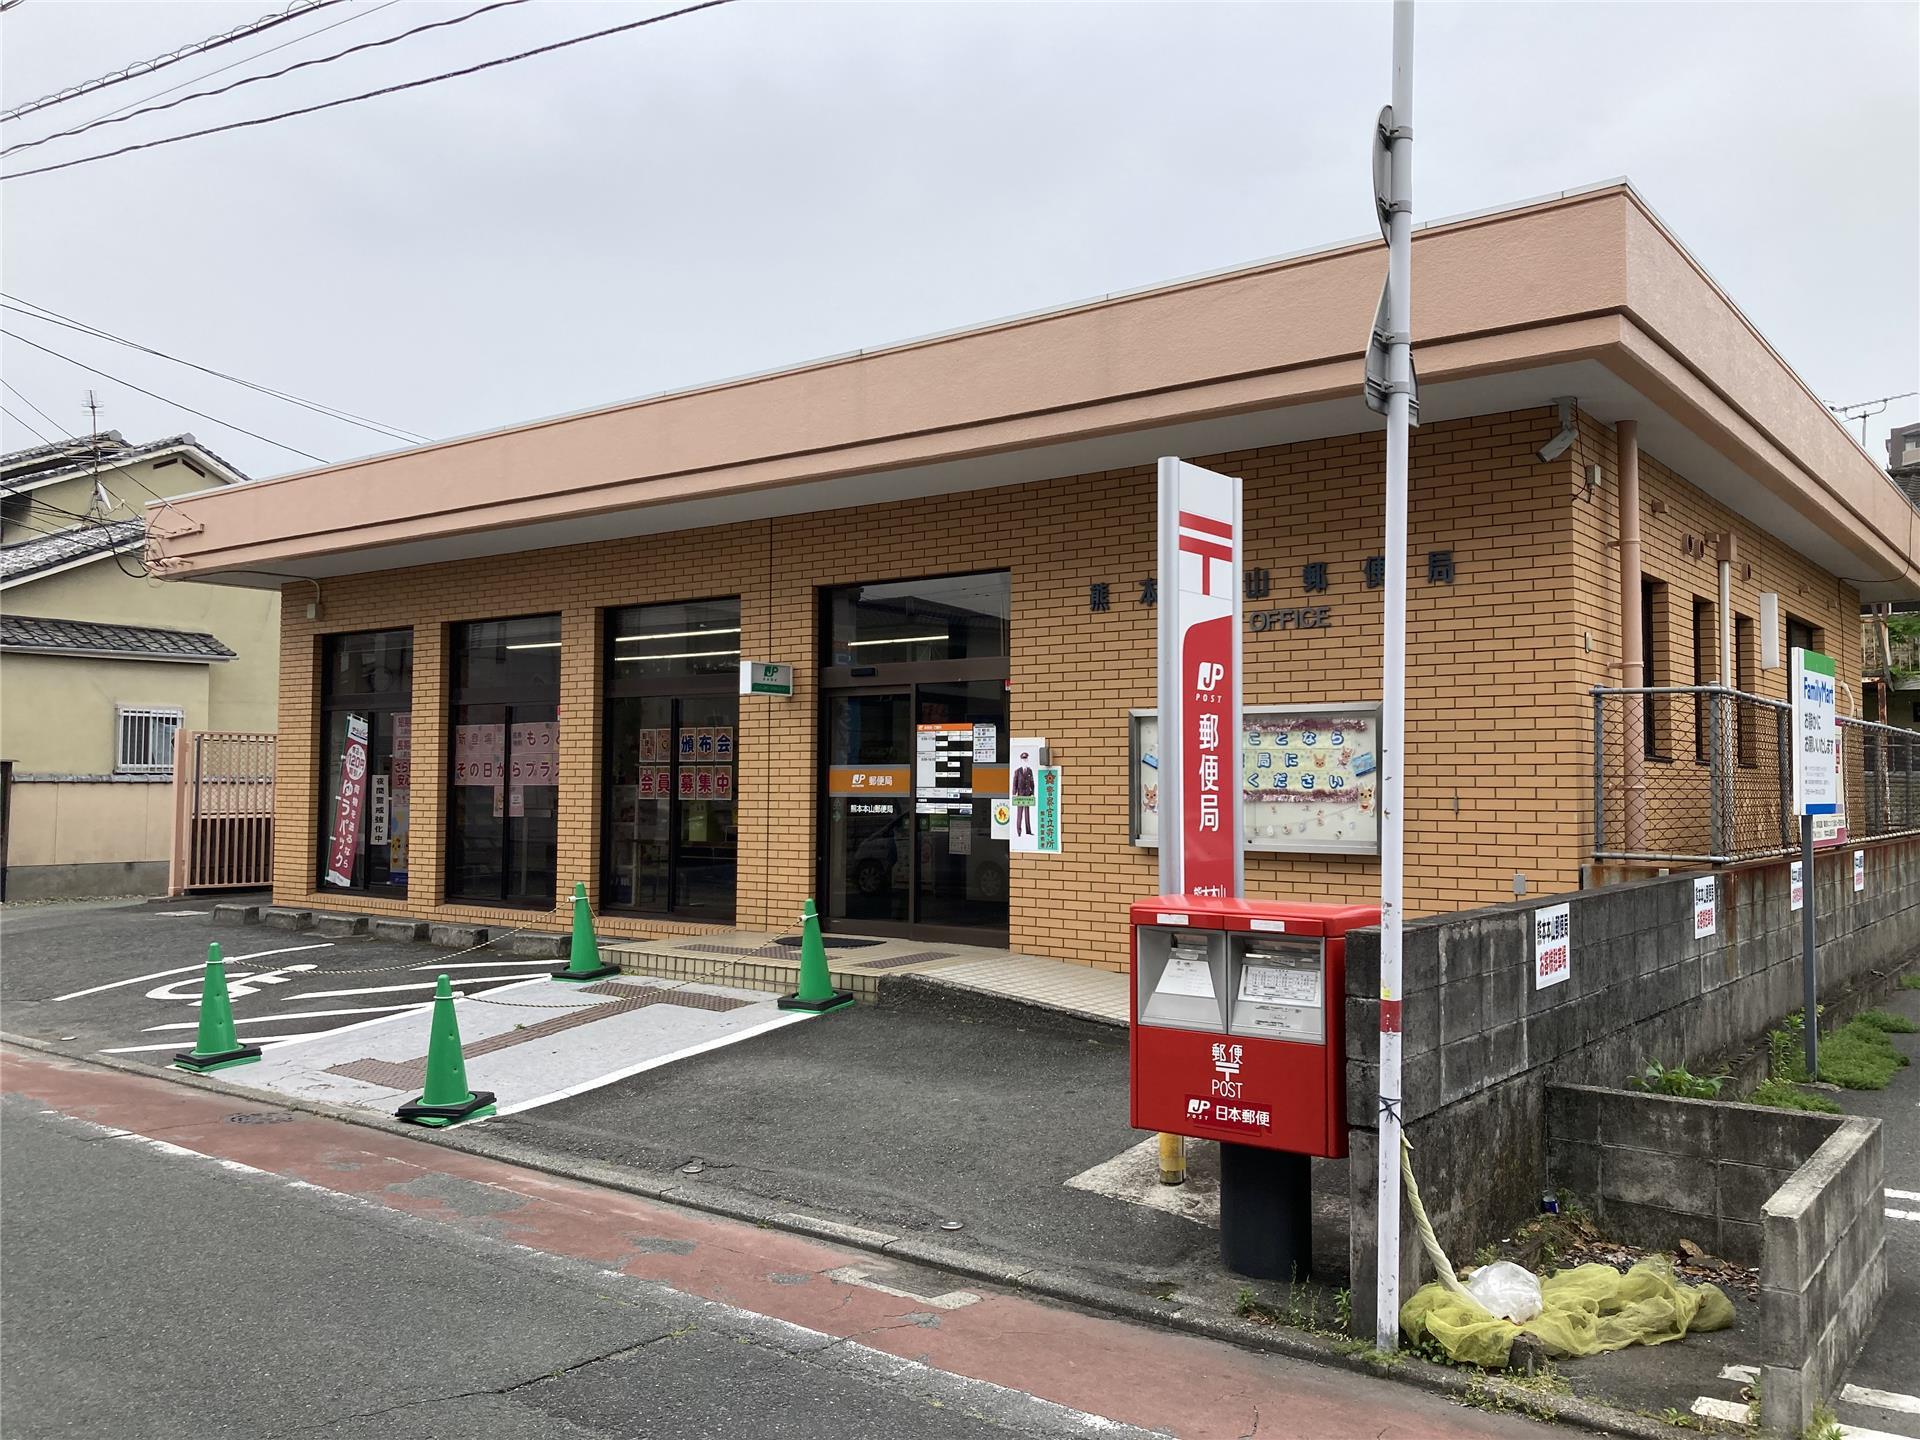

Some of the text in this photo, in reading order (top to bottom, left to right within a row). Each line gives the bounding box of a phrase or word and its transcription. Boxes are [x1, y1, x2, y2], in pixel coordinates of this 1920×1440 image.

[1089, 550, 1455, 612] 熊本山郵便局
[1248, 606, 1333, 633] OFFICE
[1197, 662, 1224, 691] JP
[1196, 693, 1222, 703] POST
[1804, 677, 1834, 707] FamilyMart
[681, 734, 731, 753] 頒布会
[1248, 731, 1345, 745] ことなら
[1243, 752, 1299, 768] 局に
[868, 776, 893, 786] 郵便局
[1199, 714, 1219, 832] 郵便局
[1248, 773, 1344, 788] ください
[641, 774, 729, 793] 会員募集中
[850, 804, 894, 814] 熊本本山郵便局
[335, 779, 353, 868] ゆうパック
[1212, 1043, 1243, 1064] 郵便
[1211, 1079, 1243, 1099] POST
[1187, 1099, 1270, 1127] JP 日本郵便
